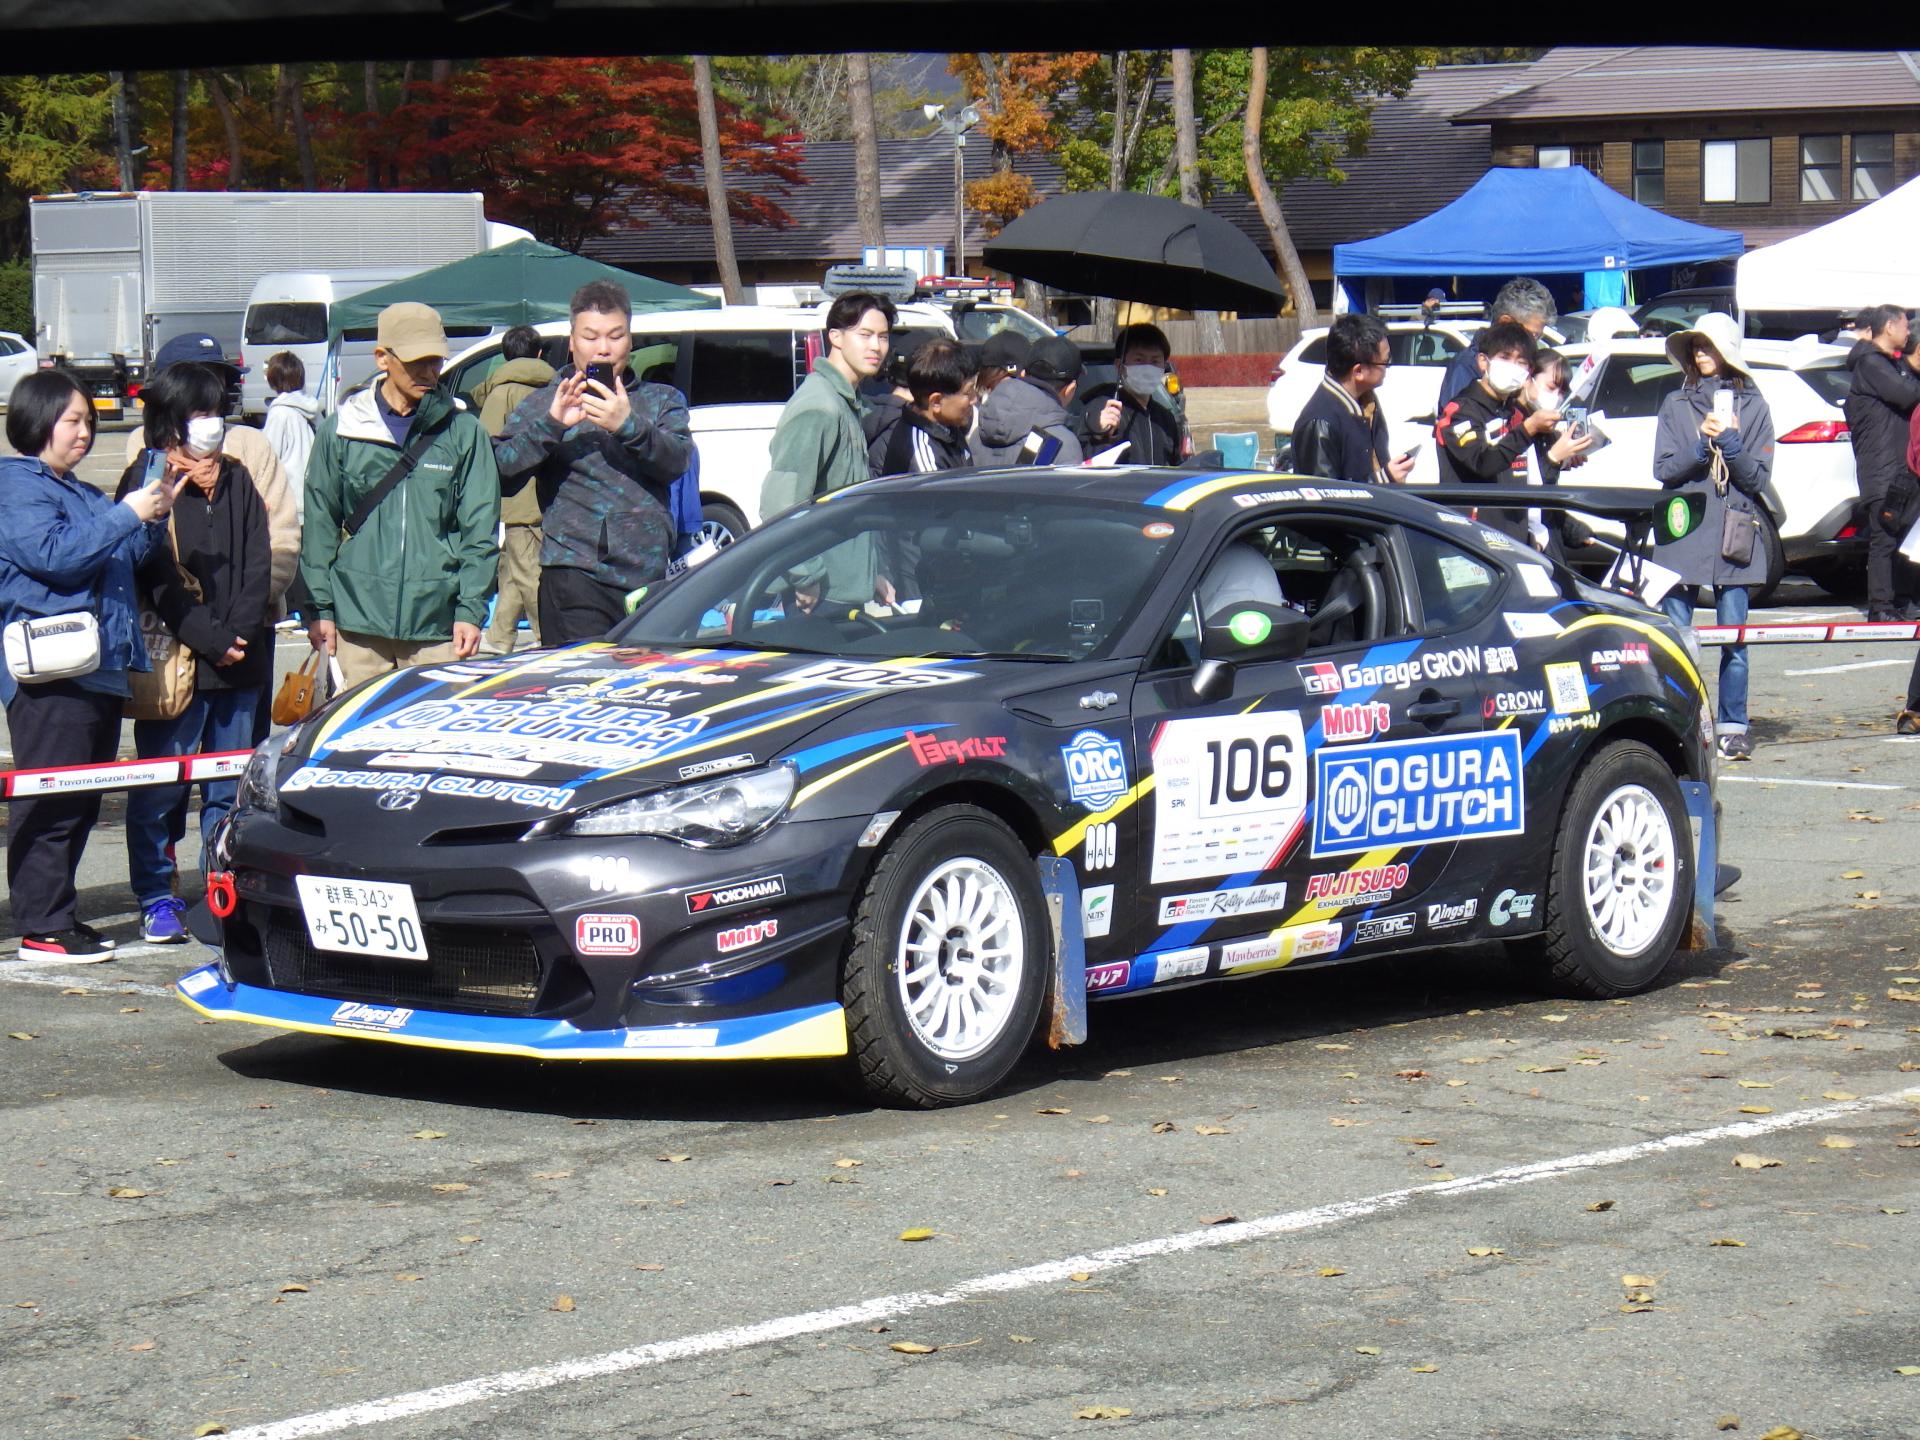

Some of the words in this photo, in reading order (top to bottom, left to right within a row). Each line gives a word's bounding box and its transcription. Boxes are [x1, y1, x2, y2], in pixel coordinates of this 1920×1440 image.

[1341, 660, 1423, 690] Garage
[1423, 645, 1481, 680] GROW
[1484, 646, 1519, 674] 盛岡
[1591, 649, 1649, 665] ADVAN
[802, 665, 952, 687] 106
[1496, 689, 1544, 711] GROW
[468, 699, 710, 737] OGURA
[1322, 701, 1391, 736] Moty's
[435, 716, 684, 752] CLUTCH
[1069, 747, 1122, 784] ORC
[1206, 734, 1294, 806] 106
[1373, 746, 1512, 796] OGURA
[58, 778, 93, 787] TOYOTA
[94, 775, 125, 784] GAZOO
[126, 772, 156, 782] Racing
[311, 769, 428, 790] OGURA
[427, 774, 576, 812] CLUTCH
[1171, 799, 1186, 808] SPK
[1371, 785, 1513, 837] CLUTCH
[711, 880, 781, 905] YOKOHAMA
[1305, 863, 1409, 901] FUJITSUBO
[326, 885, 358, 906] 群馬
[358, 888, 388, 908] 343
[1210, 892, 1245, 913] Rally
[1317, 898, 1355, 909] EXHAUST
[1354, 892, 1392, 906] SYSTEMS
[1087, 910, 1105, 922] NUTS
[315, 918, 328, 934] み
[329, 909, 418, 953] 50-50
[589, 926, 626, 943] PRO
[718, 920, 778, 951] Moty's
[1226, 947, 1277, 965] Mawberries
[1086, 968, 1124, 989] トレア
